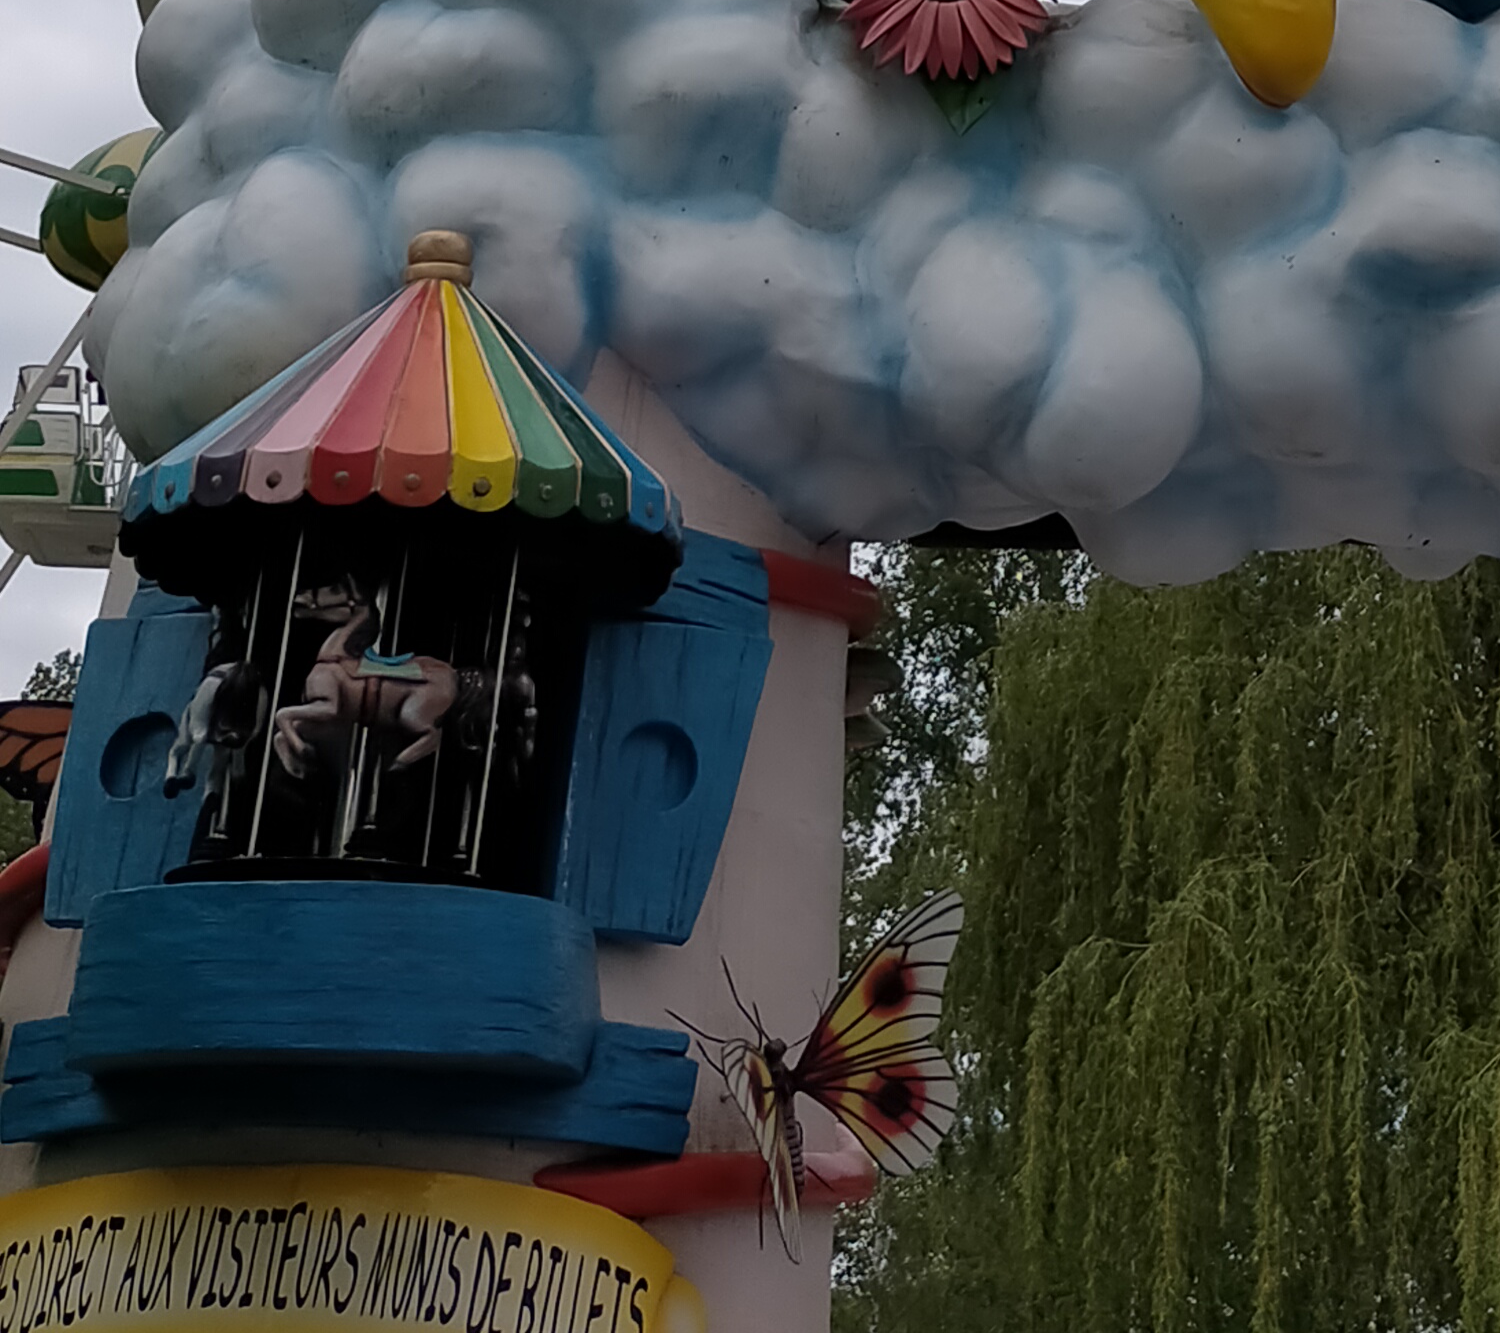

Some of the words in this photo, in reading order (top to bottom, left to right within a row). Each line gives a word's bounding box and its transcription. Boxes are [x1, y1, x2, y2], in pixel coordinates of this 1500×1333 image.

[20, 1215, 126, 1333] DIRECT
[114, 1205, 191, 1313] AUX
[187, 1201, 367, 1315] VISITEURS
[360, 1211, 470, 1325] MUNIS
[466, 1231, 522, 1333] DE
[515, 1239, 648, 1333] BILLETS
